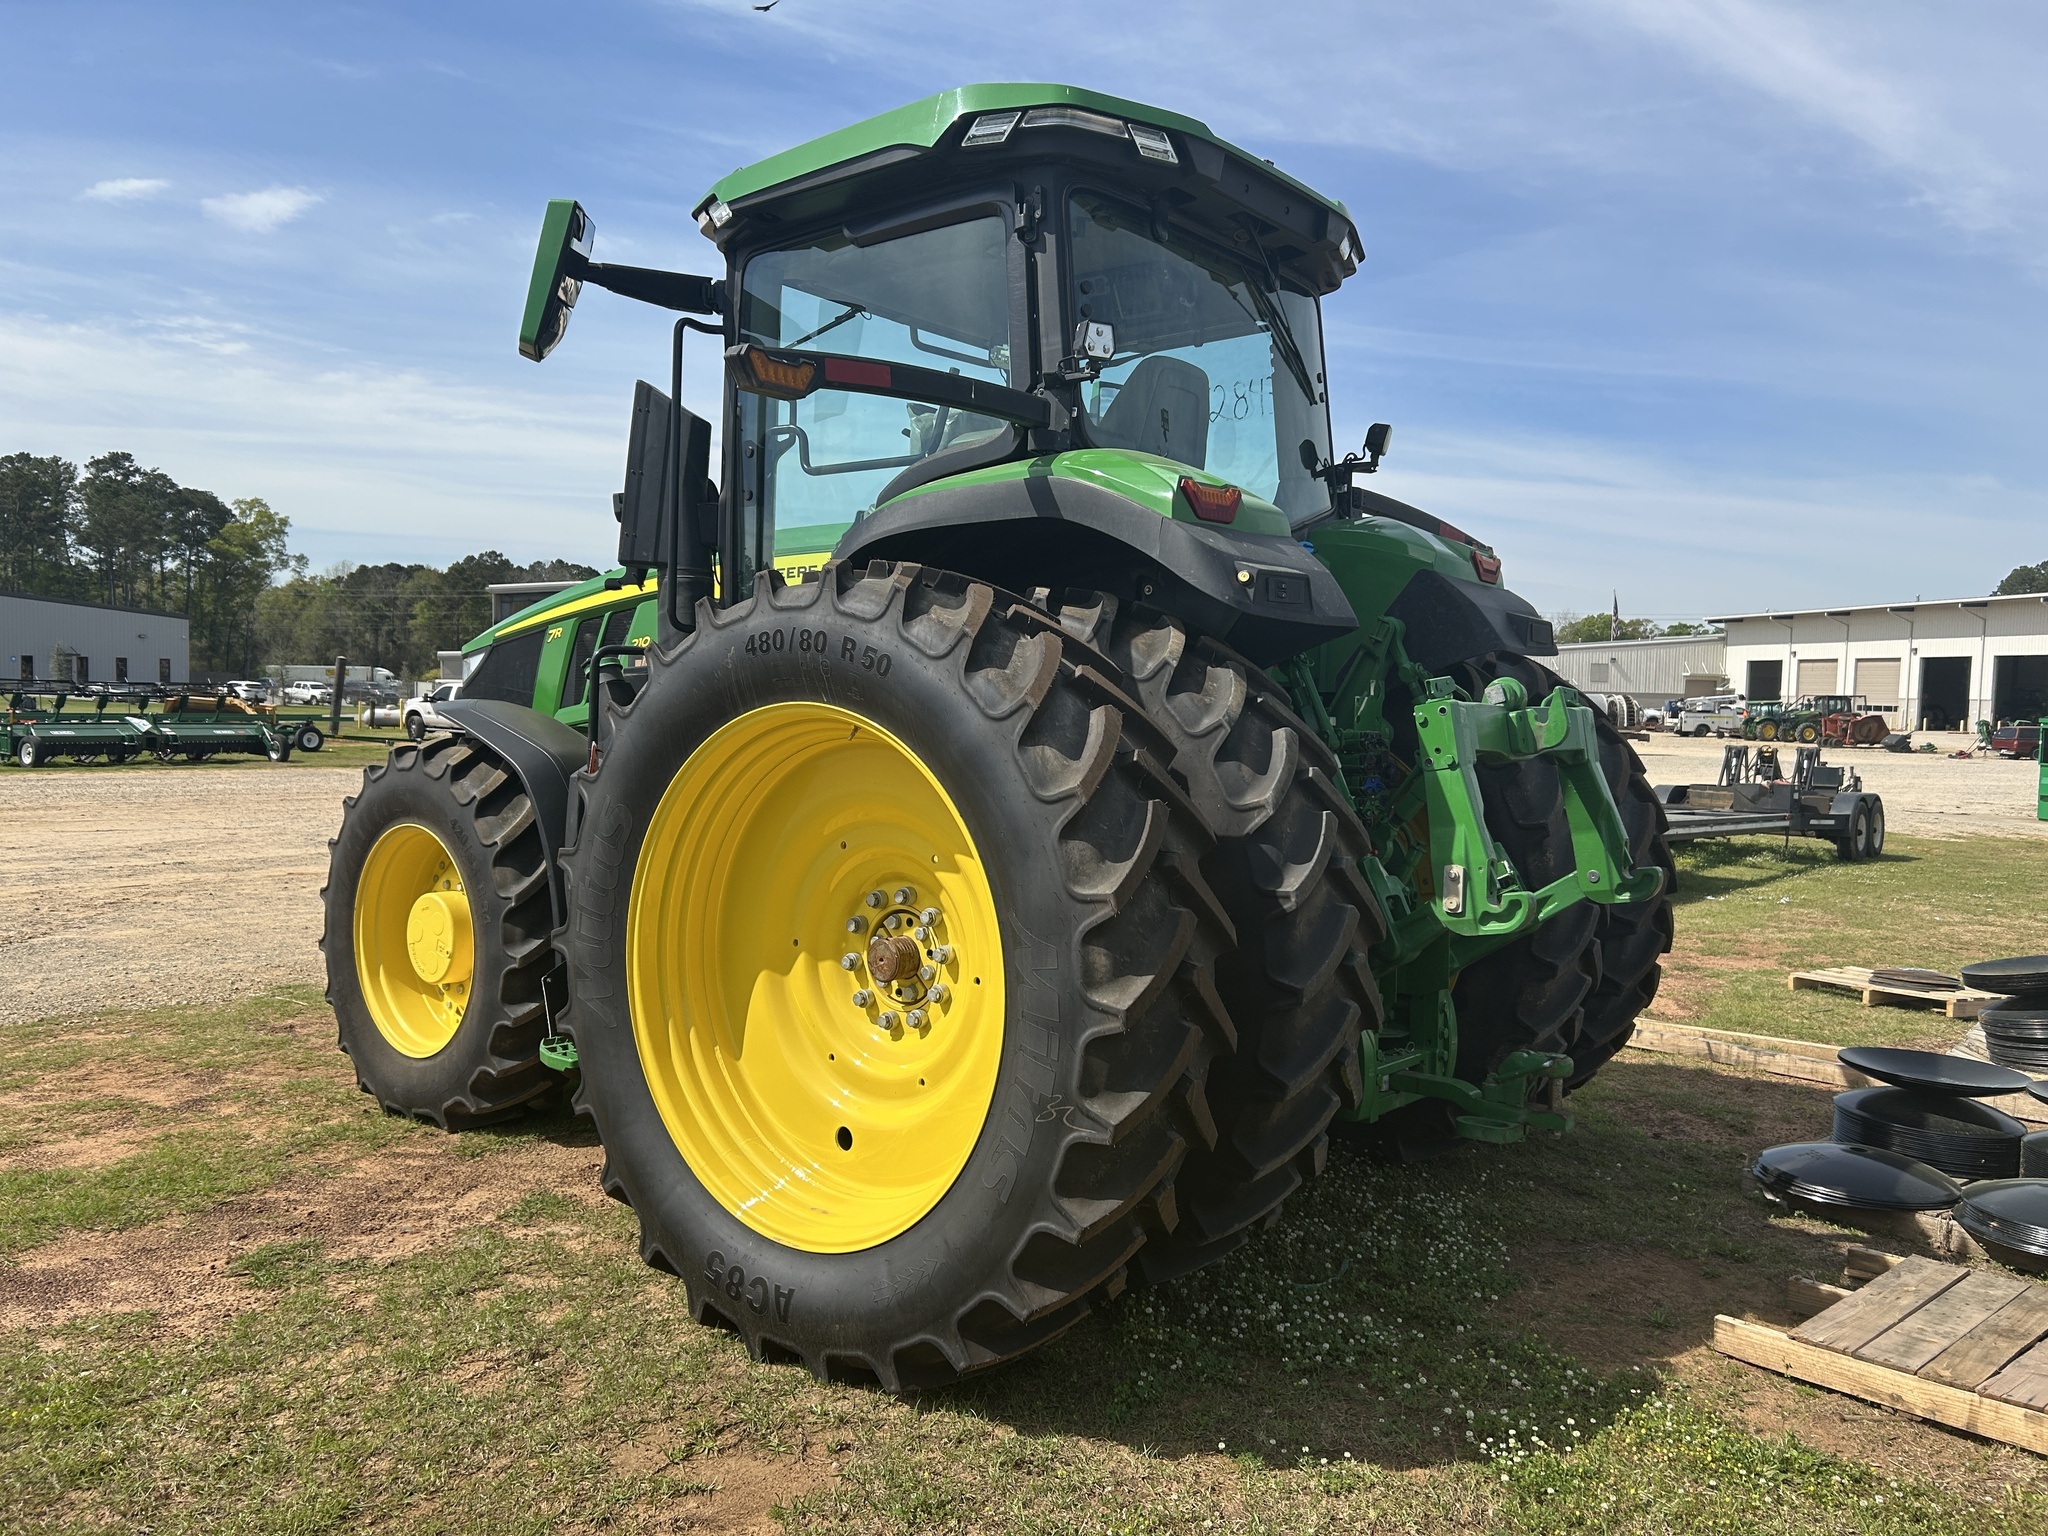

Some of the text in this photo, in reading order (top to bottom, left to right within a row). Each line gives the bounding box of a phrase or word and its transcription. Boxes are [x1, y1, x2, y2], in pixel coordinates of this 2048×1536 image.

[546, 627, 563, 643] 7R
[631, 635, 651, 648] 210
[745, 627, 828, 657] 480/80
[840, 635, 858, 664] R
[860, 645, 892, 679] 50
[703, 1248, 797, 1325] AC85
